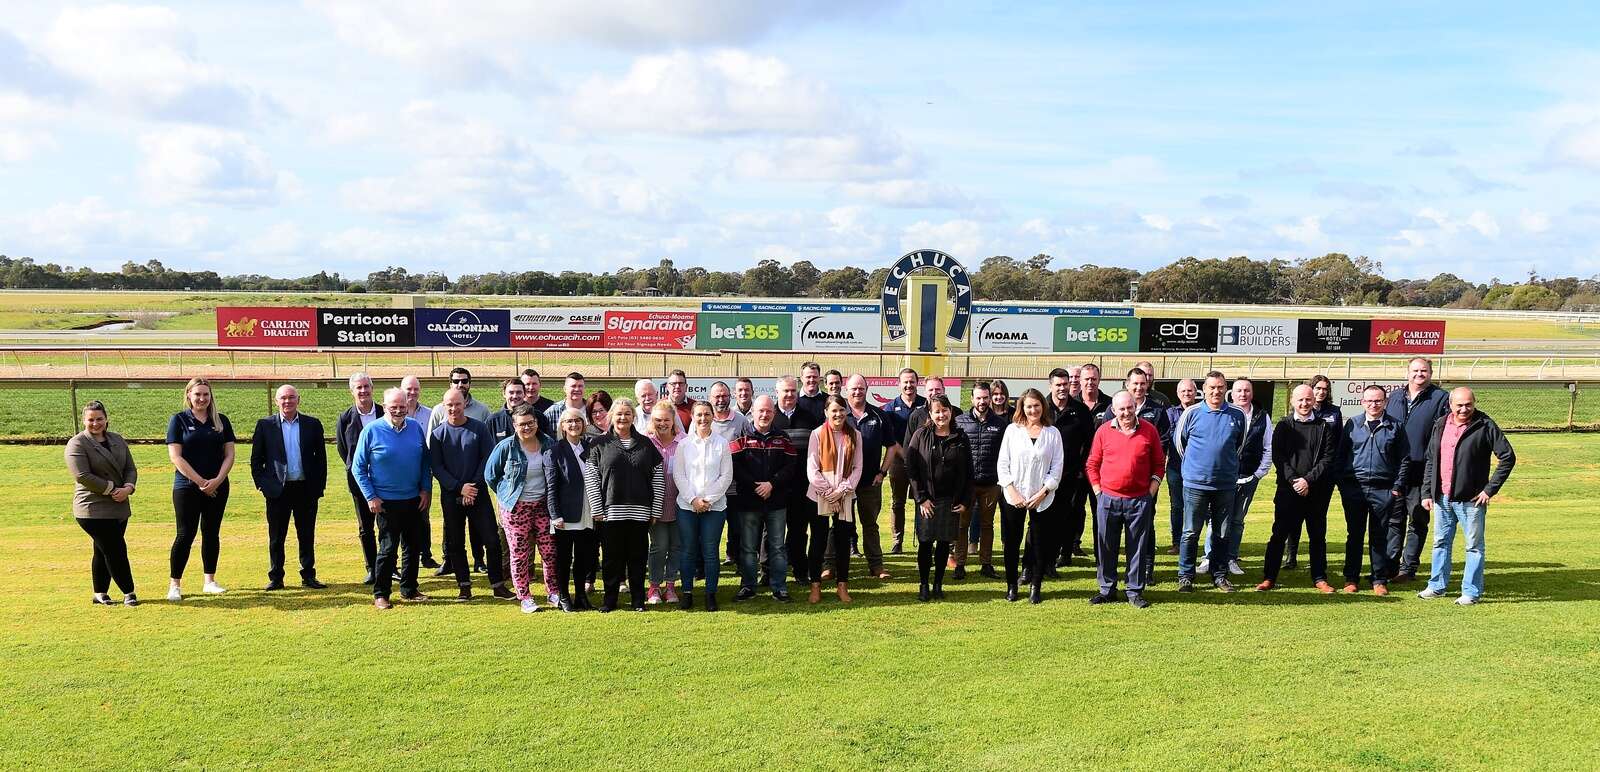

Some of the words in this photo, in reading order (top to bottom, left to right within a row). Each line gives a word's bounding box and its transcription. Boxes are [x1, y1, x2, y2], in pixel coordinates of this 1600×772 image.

[885, 253, 970, 297] ECHUCA
[323, 313, 408, 325] Perricoota
[261, 320, 310, 329] CARLTON
[427, 323, 499, 333] CALEDONIAN
[607, 316, 694, 333] Signarama
[1160, 320, 1199, 339] edg
[1317, 321, 1339, 336] Border
[1340, 322, 1351, 336] Inn
[263, 329, 309, 337] DRAUGHT
[710, 323, 780, 340] bet365
[807, 331, 855, 340] MOAMA
[1066, 326, 1128, 342] bet365
[1240, 325, 1284, 336] BOURKE
[1403, 331, 1441, 339] CARLTON
[337, 330, 396, 342] Station
[515, 333, 600, 341] www.echucacih.com
[985, 332, 1029, 341] MOAMA
[1240, 336, 1291, 346] BUILDERS
[1340, 397, 1362, 406] Janin
